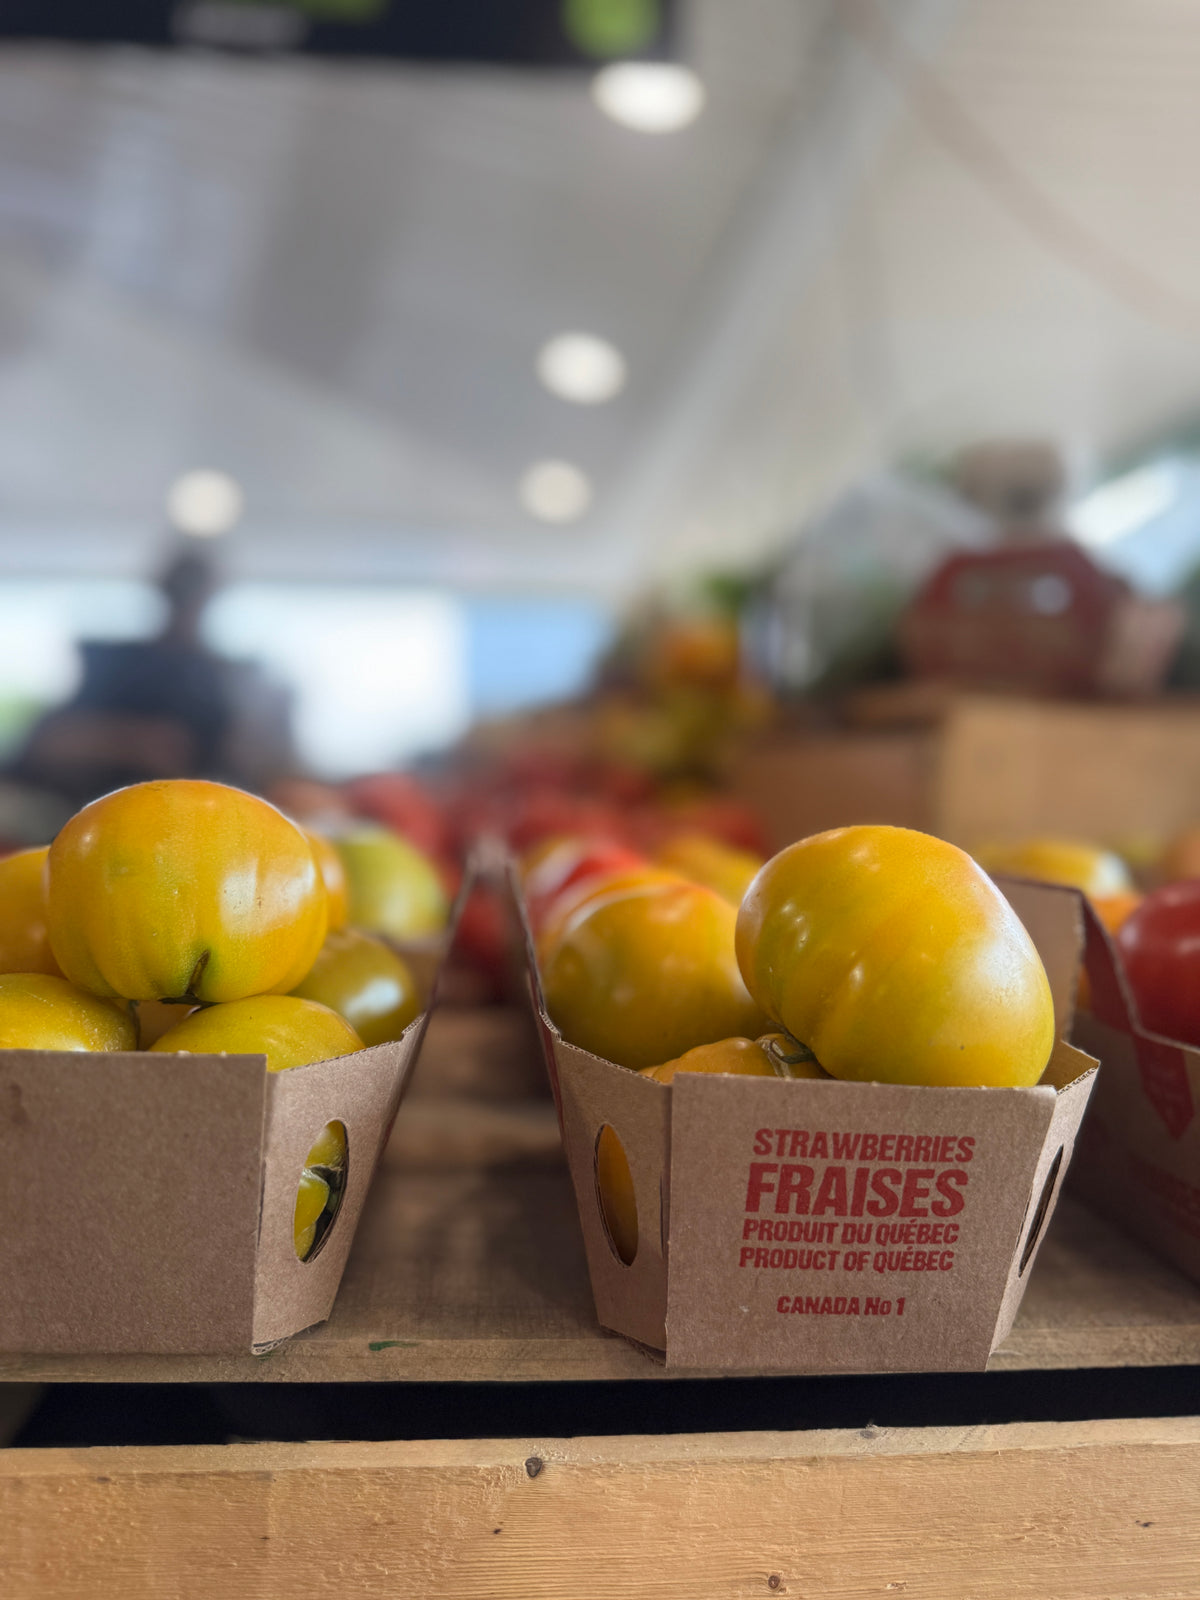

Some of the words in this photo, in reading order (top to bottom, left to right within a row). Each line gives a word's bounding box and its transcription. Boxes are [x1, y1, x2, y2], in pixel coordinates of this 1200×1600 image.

[753, 1128, 976, 1163] STRAWBERRIES
[745, 1162, 969, 1218] FRAISES
[742, 1218, 839, 1244] PRODUIT
[841, 1222, 873, 1245] DU
[875, 1218, 960, 1247] QUÉBEC
[739, 1246, 841, 1271] PRODUCT
[842, 1250, 871, 1272] OF
[872, 1246, 955, 1274] QUÉBEC
[776, 1296, 860, 1316] CANADA
[864, 1297, 892, 1316] No
[896, 1297, 906, 1316] 1
